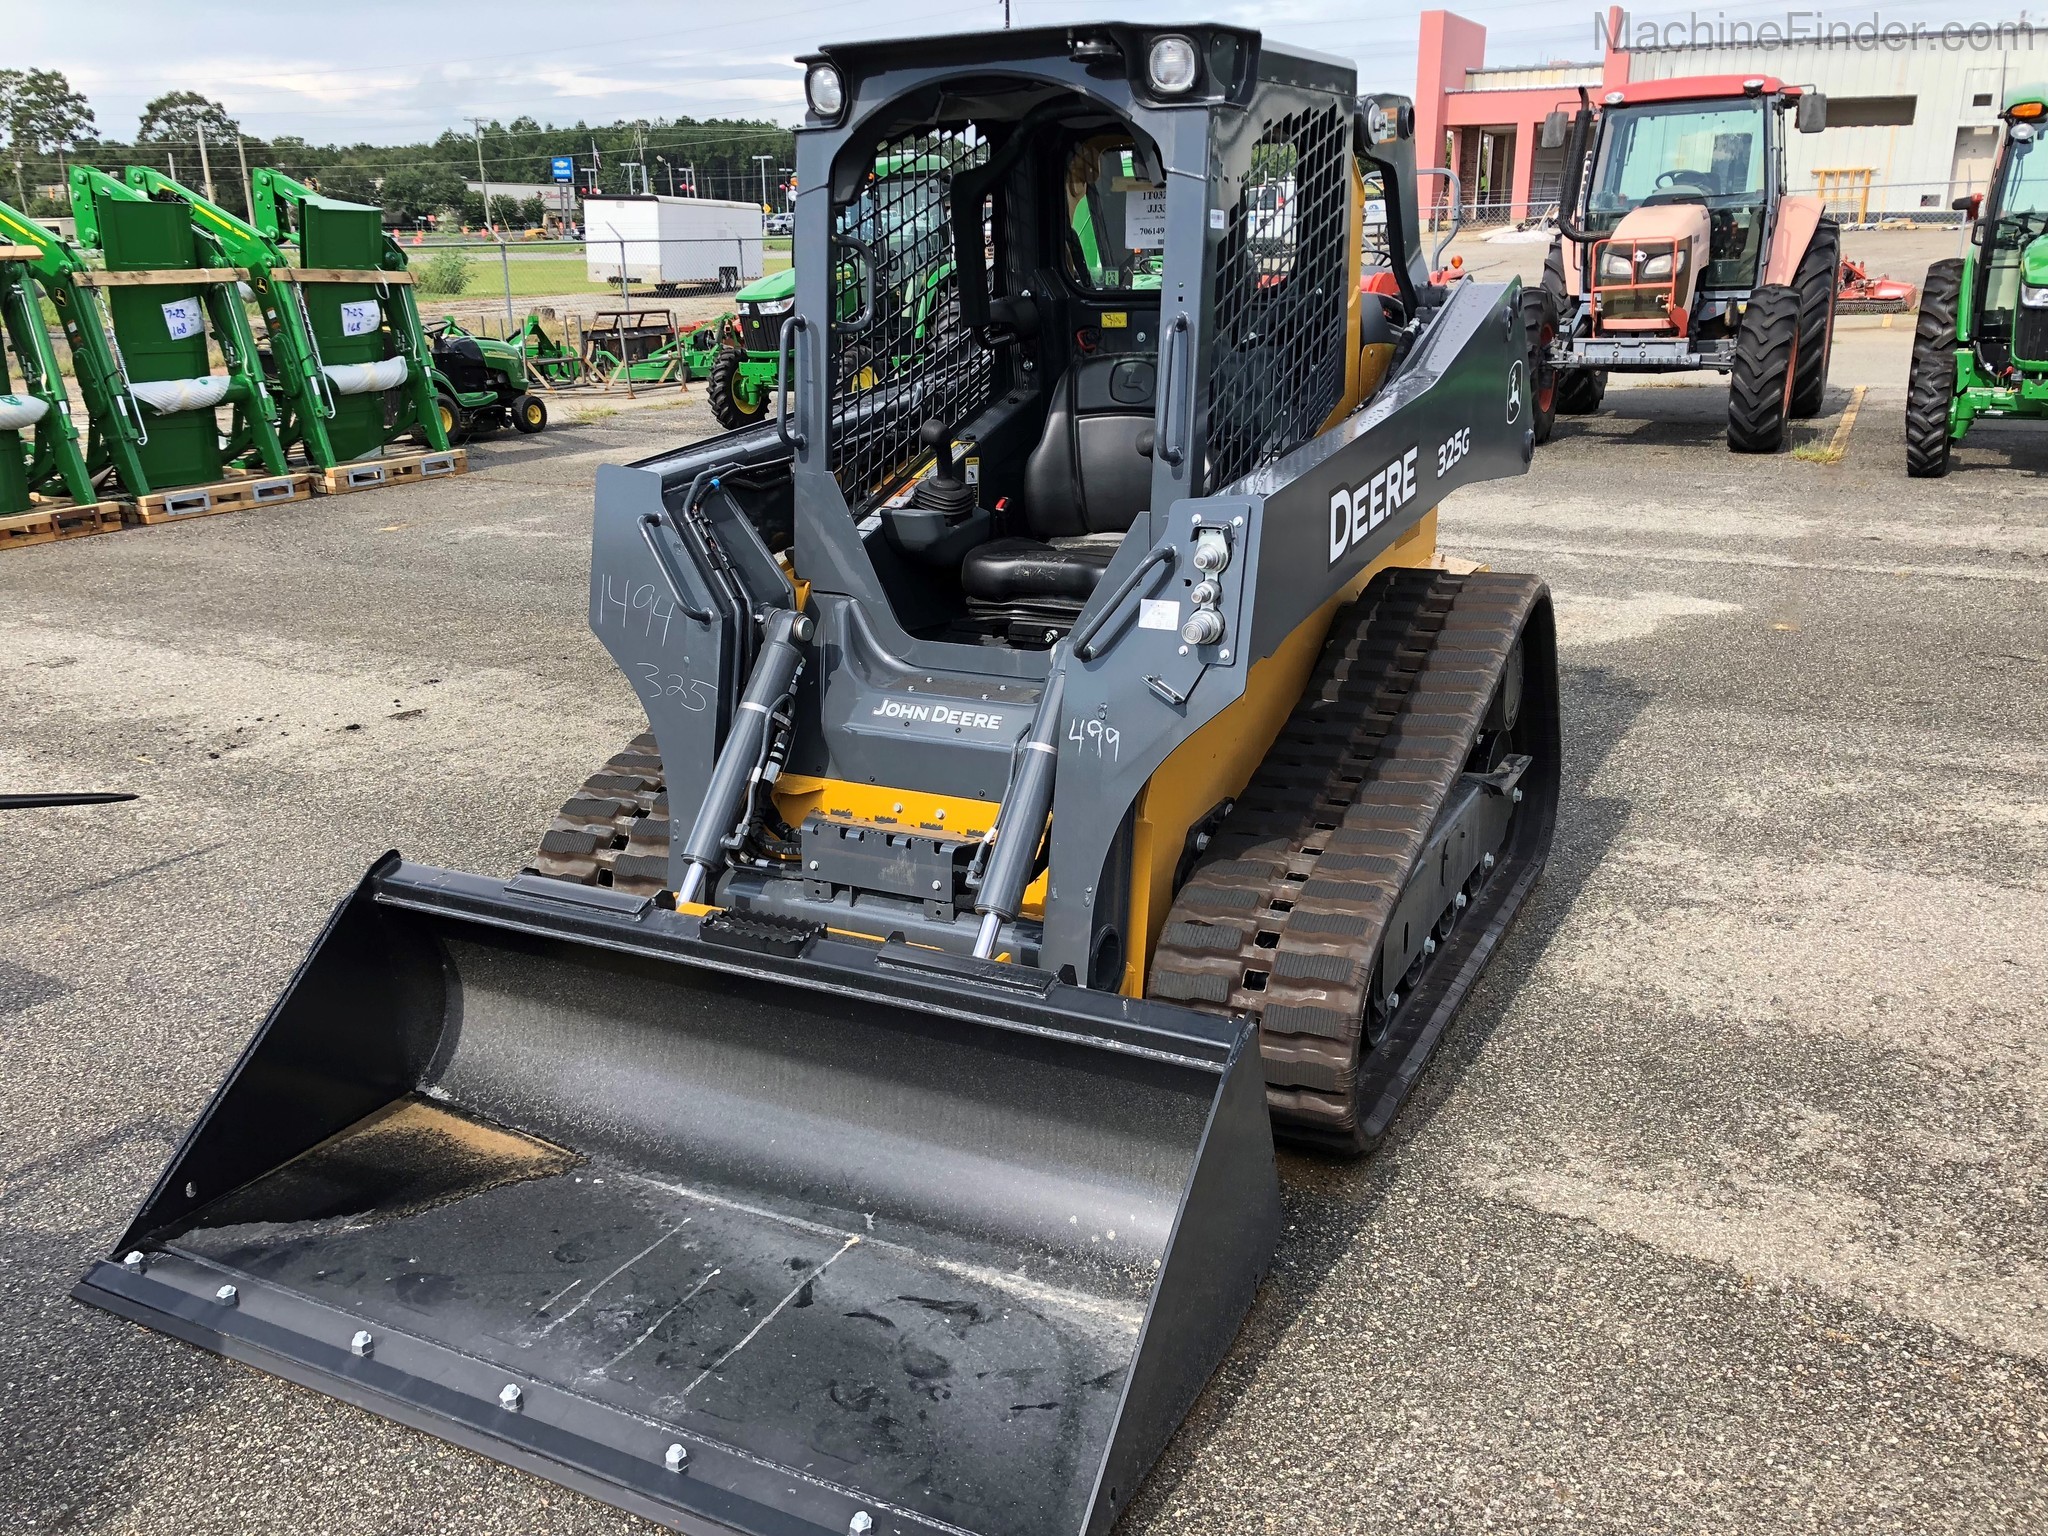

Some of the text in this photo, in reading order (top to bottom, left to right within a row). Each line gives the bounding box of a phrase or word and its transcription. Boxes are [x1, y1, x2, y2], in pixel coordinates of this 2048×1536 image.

[1329, 427, 1470, 564] DEERE 325G
[600, 573, 676, 648] 1494
[636, 662, 718, 712] 325
[873, 699, 1003, 730] JOHN DEERE
[1069, 718, 1120, 762] 499
